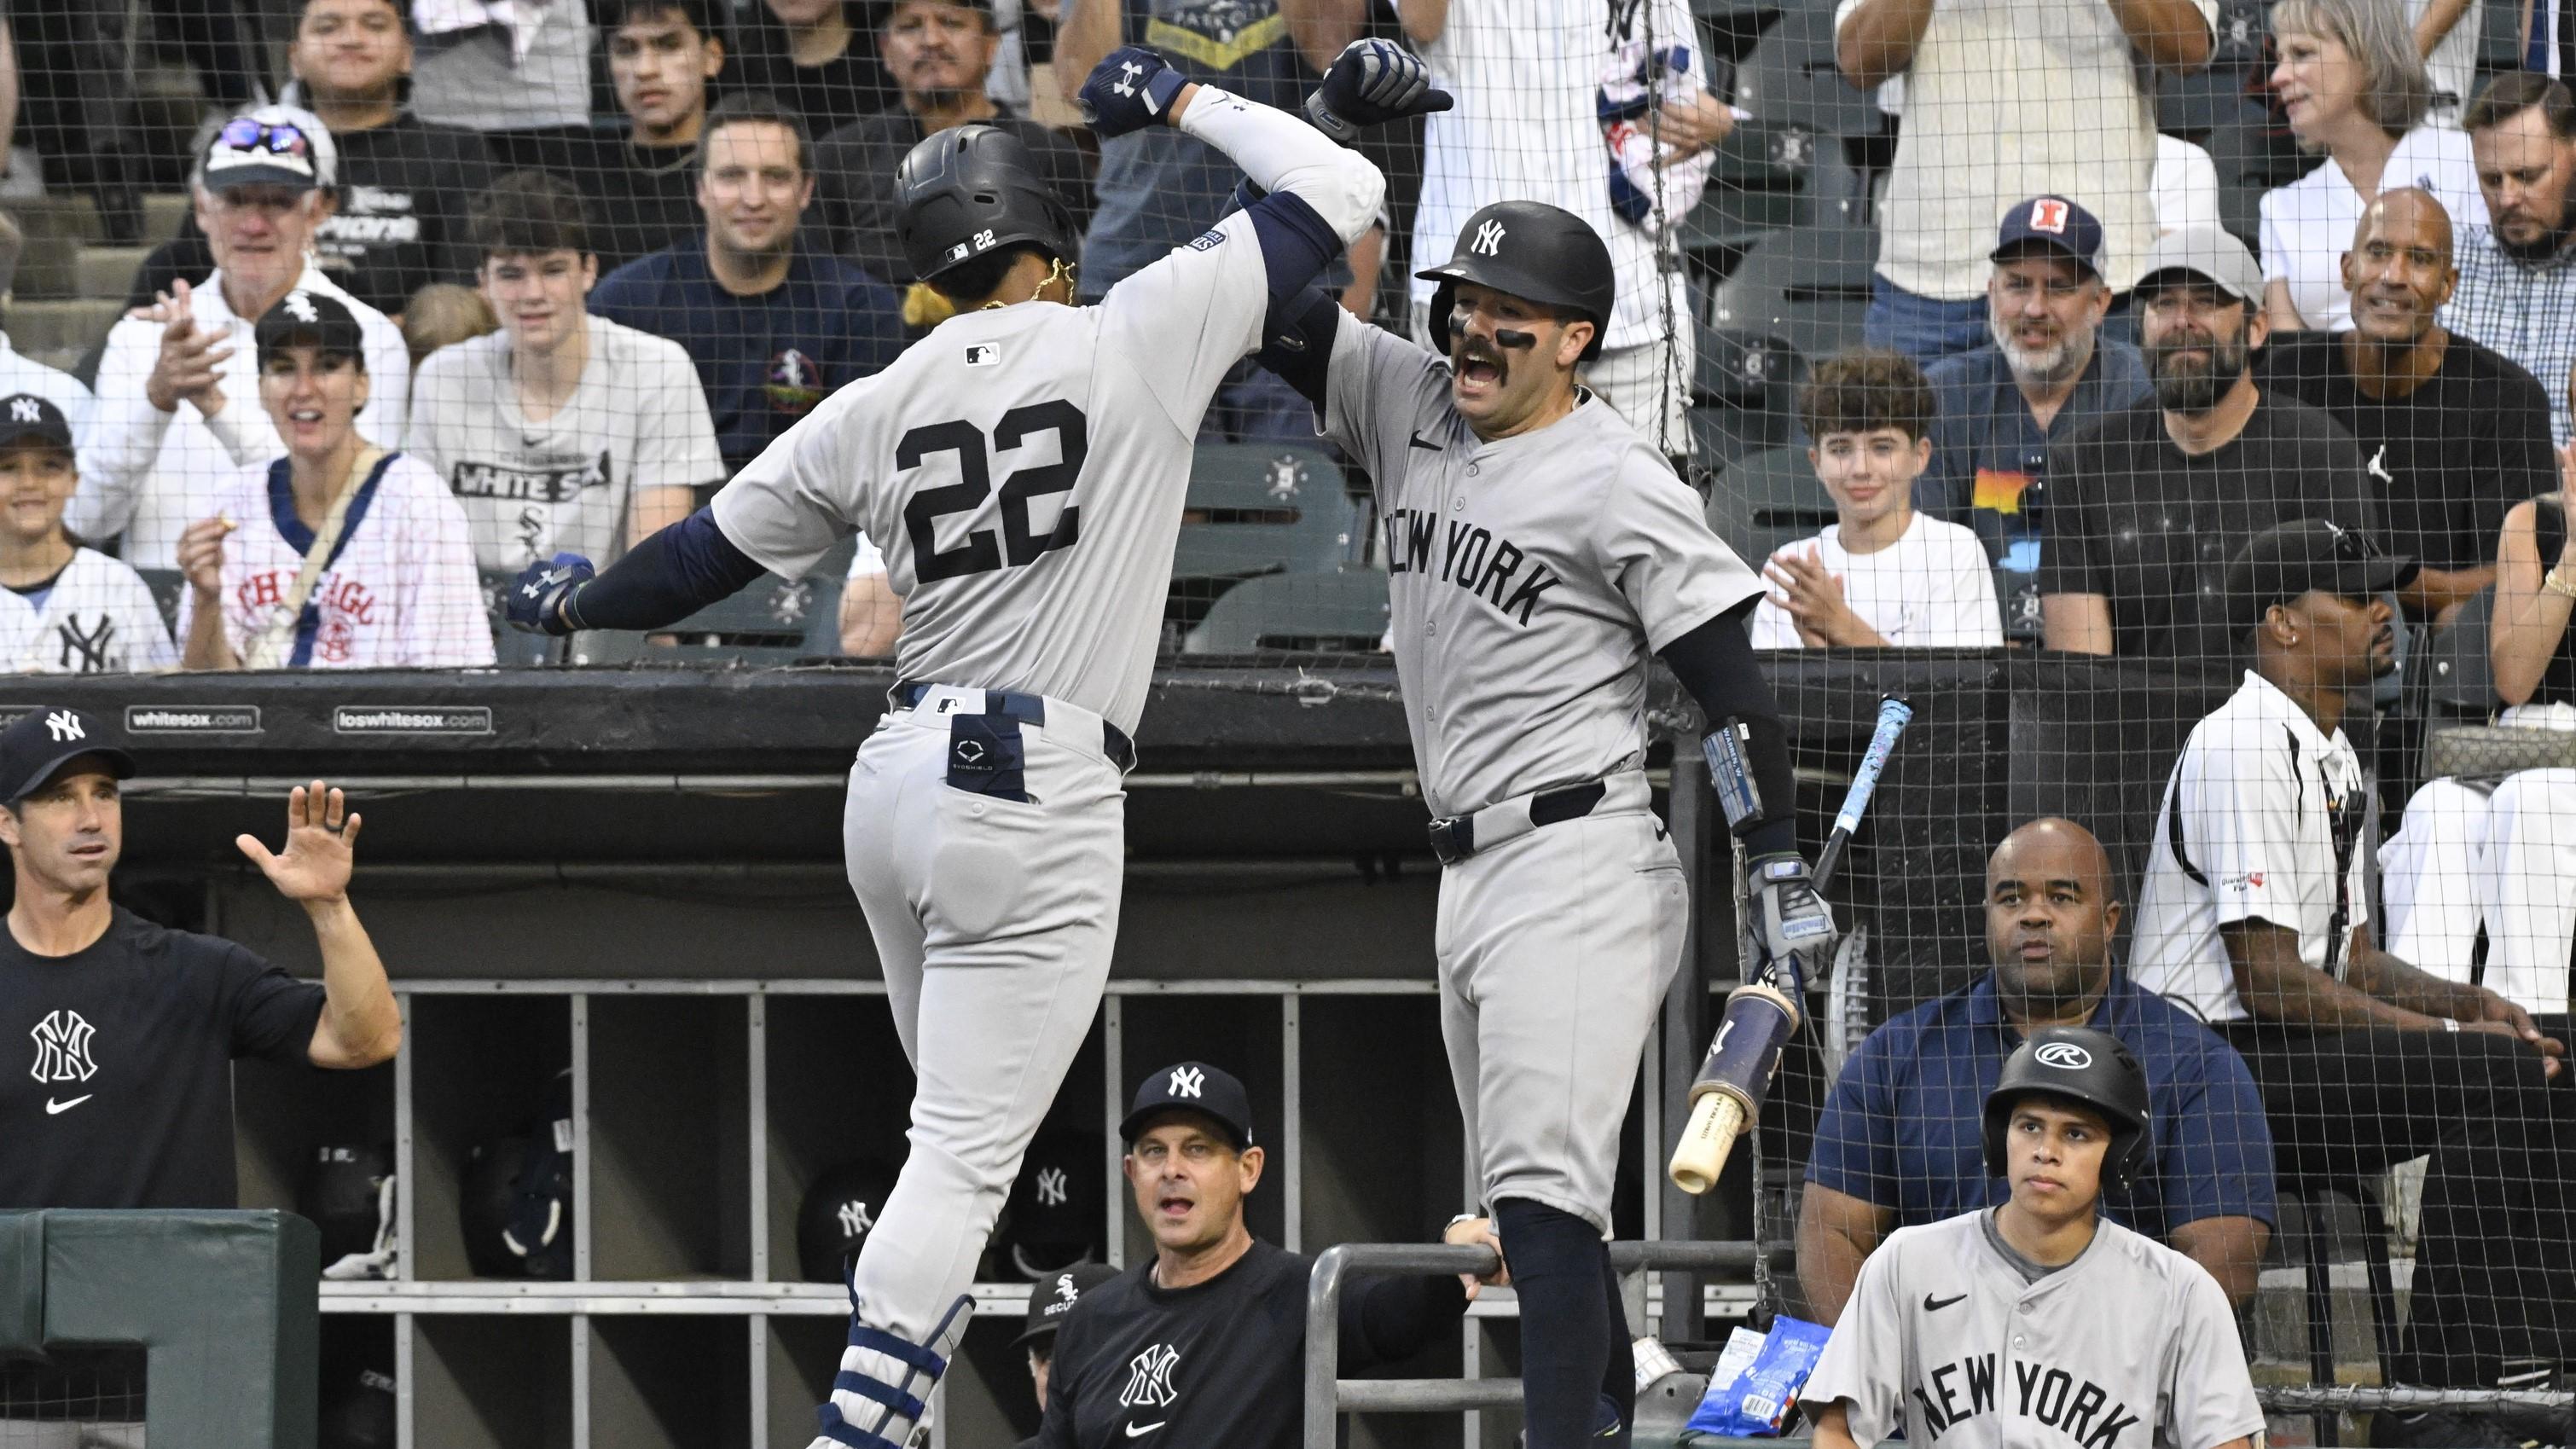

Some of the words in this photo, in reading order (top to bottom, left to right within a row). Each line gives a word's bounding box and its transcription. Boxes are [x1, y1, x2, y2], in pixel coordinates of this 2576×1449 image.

[973, 229, 996, 251] 22
[1471, 218, 1506, 257] NY
[10, 397, 42, 424] NY
[458, 465, 548, 498] WHITE
[896, 398, 1088, 585] 22
[1442, 520, 1563, 628] YORK
[58, 613, 115, 672] NY
[45, 710, 86, 742] NY
[132, 711, 253, 727] whitesox.com
[339, 711, 486, 727] loswhitesox.com
[953, 762, 993, 771] EVOSHIELD
[30, 1009, 99, 1083] NY
[1167, 1066, 1206, 1098] NY
[1036, 1167, 1067, 1207] NY
[837, 1199, 873, 1237] NY
[1118, 1343, 1181, 1408] NY
[1912, 1353, 1996, 1441] NEW
[2015, 1359, 2140, 1449] YORK
